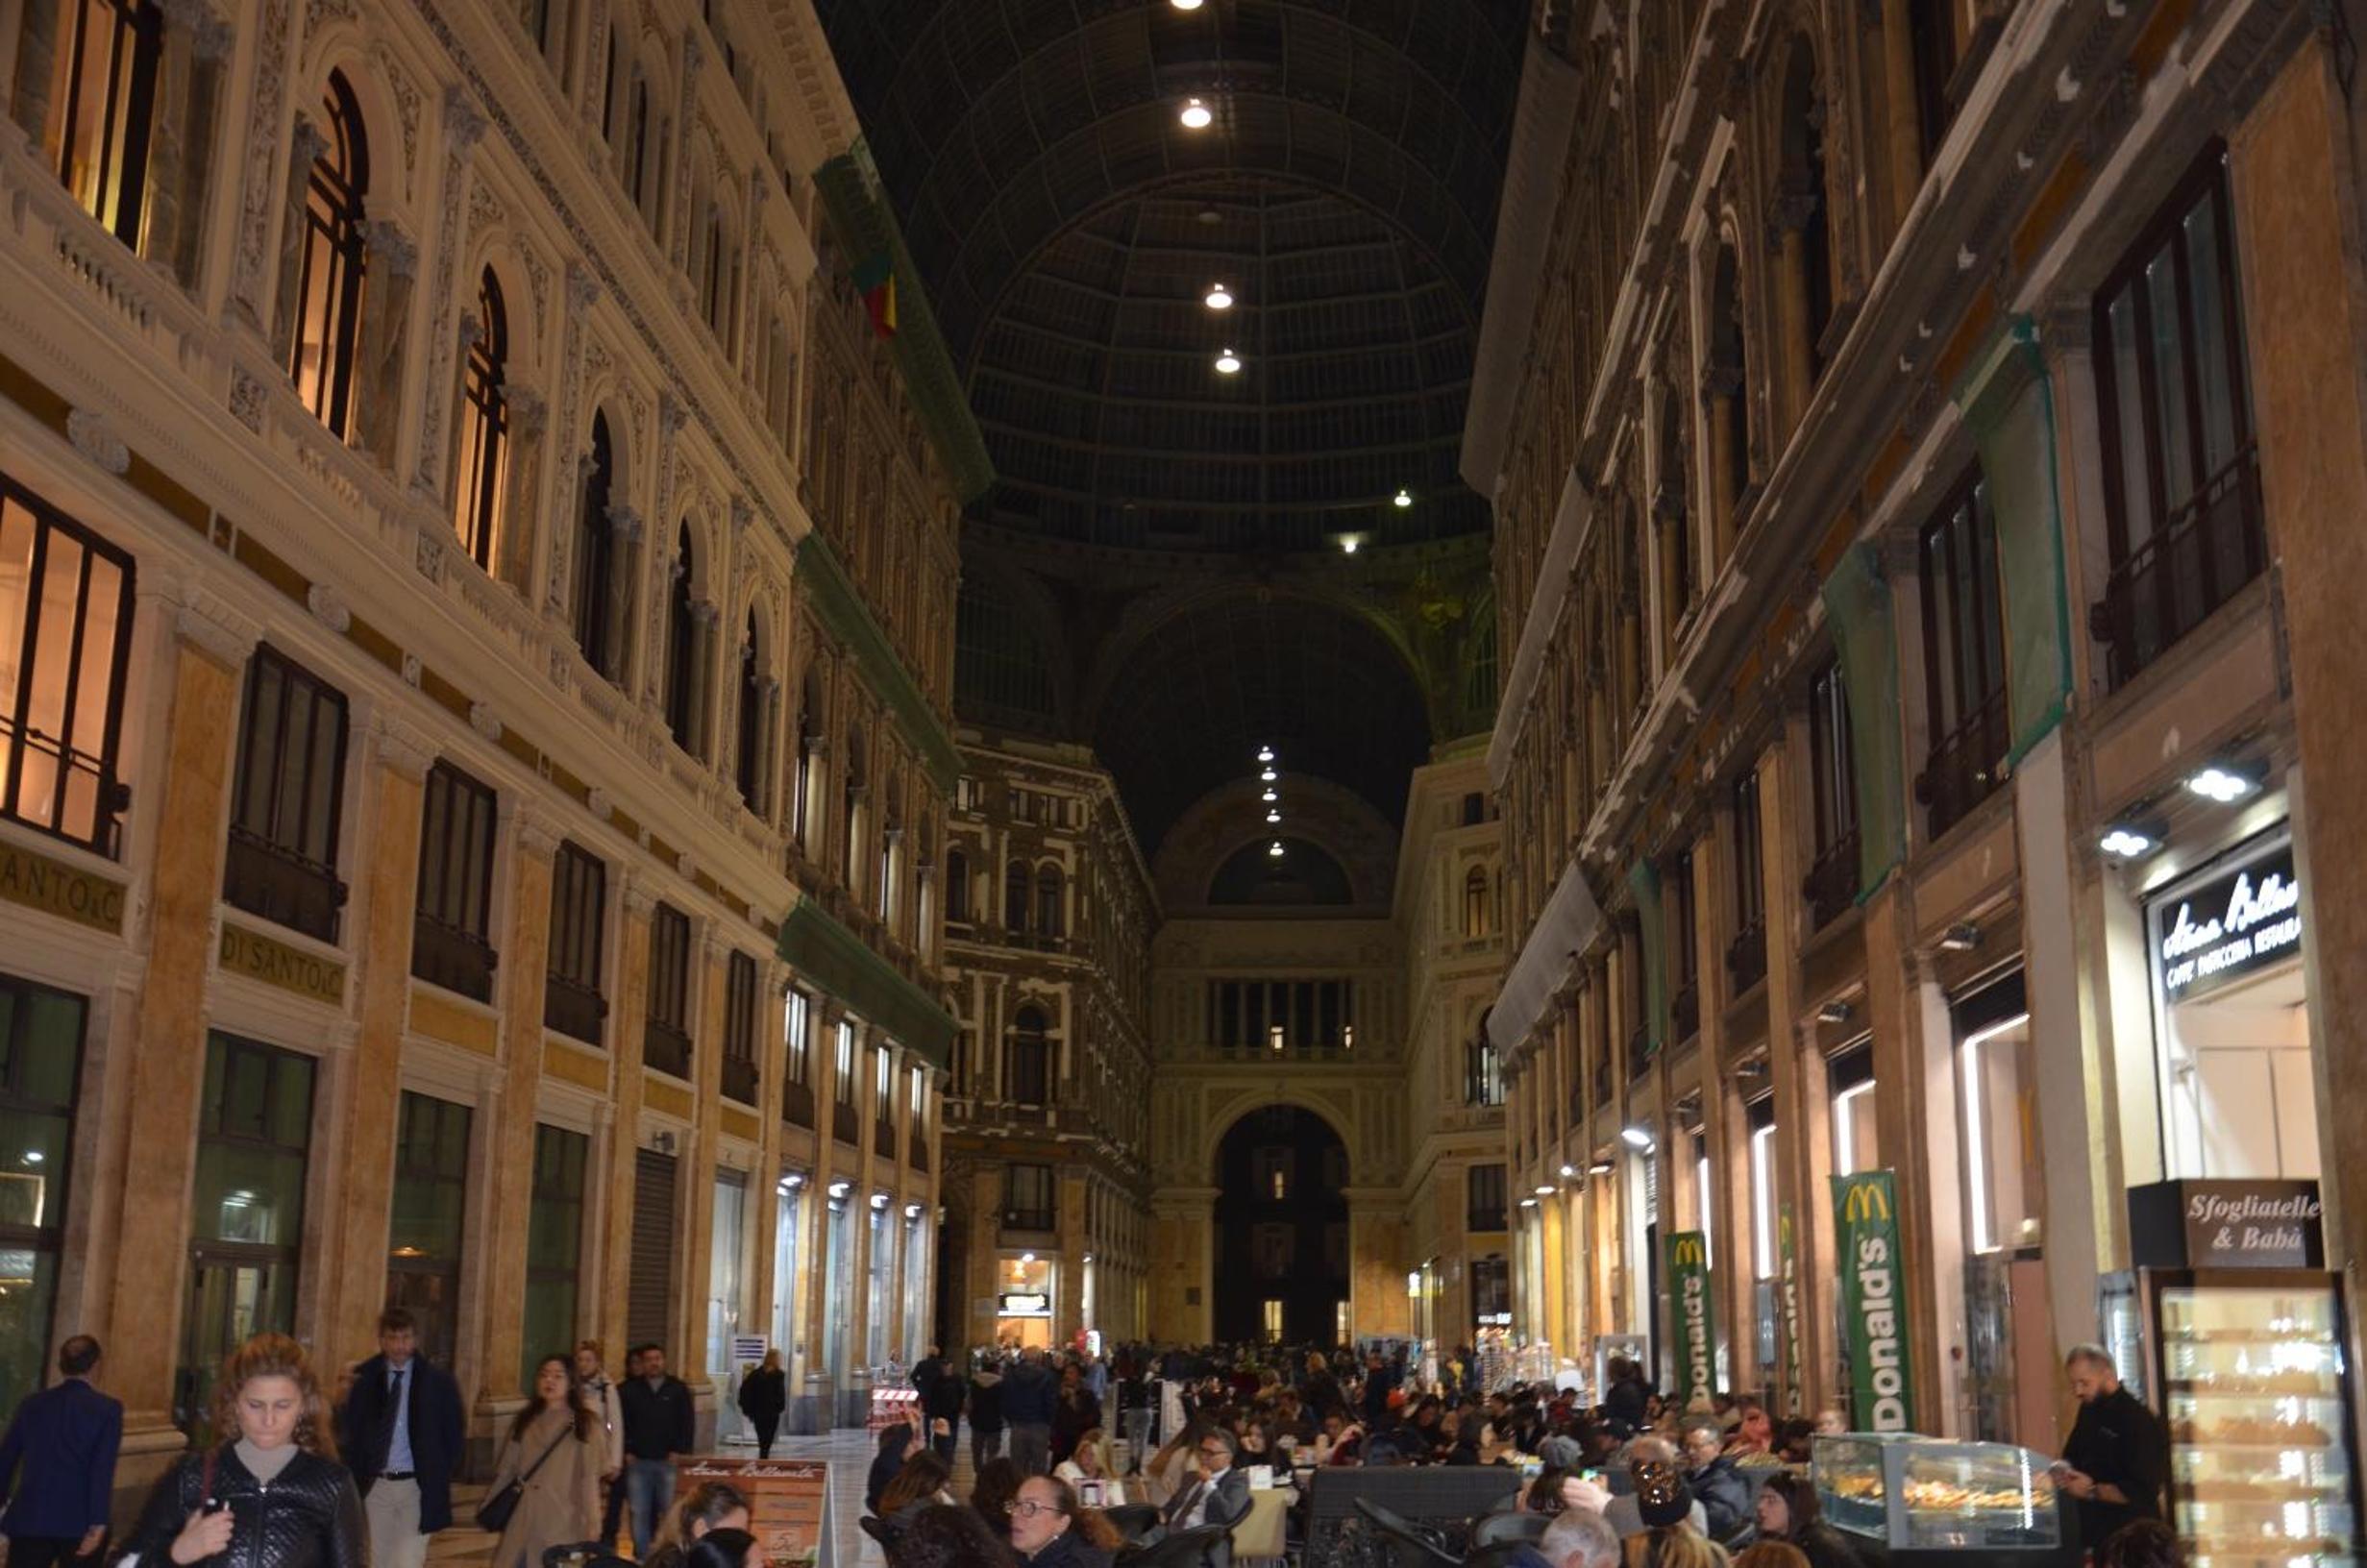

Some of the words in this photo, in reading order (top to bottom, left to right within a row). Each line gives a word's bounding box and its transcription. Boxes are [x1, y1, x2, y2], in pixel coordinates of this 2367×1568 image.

[0, 853, 89, 913] ANTO
[2223, 872, 2299, 933] Bellav
[2254, 916, 2303, 955] RESTAURA
[250, 941, 321, 991] SANTO
[2186, 1193, 2321, 1225] Sfogliatelle
[2211, 1225, 2234, 1250] &
[2240, 1225, 2304, 1251] Babà
[1683, 1275, 1711, 1405] Donald's
[1857, 1236, 1908, 1433] Donald's
